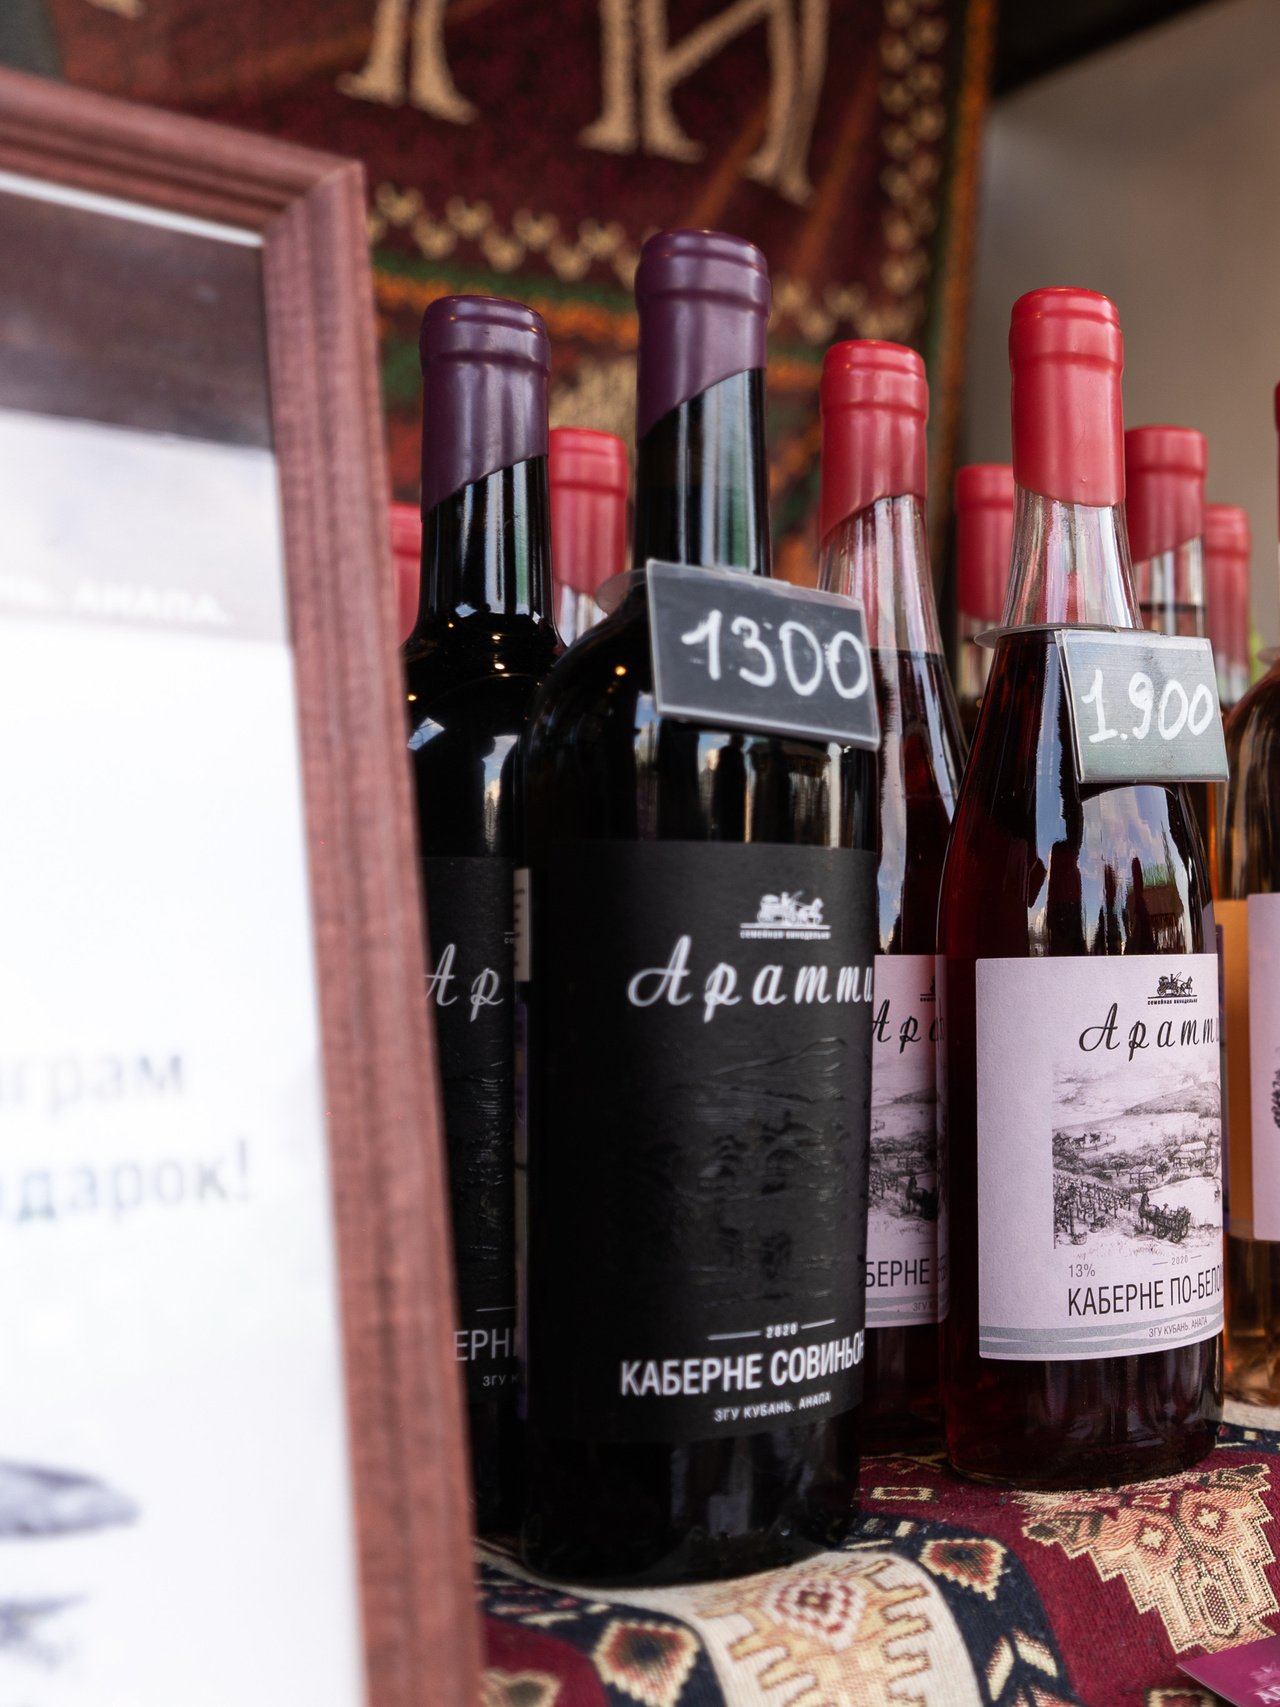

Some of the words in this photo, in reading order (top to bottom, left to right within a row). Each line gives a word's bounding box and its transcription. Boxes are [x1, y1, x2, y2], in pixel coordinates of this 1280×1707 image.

[680, 608, 870, 700] 1300
[1080, 668, 1215, 744] 1.900
[0, 1048, 187, 1122] грам
[0, 1132, 253, 1227] дарок!
[1067, 1263, 1096, 1278] 13%
[1171, 1255, 1189, 1266] 2020
[1068, 1279, 1165, 1317] КАБЕРНЕ
[765, 1321, 799, 1339] 2020
[1148, 1327, 1163, 1339] ЗГУ
[620, 1353, 763, 1396] КАБЕРНЕ
[770, 1328, 865, 1387] СОВИНЬОН
[714, 1407, 741, 1423] ЗГУ
[799, 1391, 832, 1410] АНАПА
